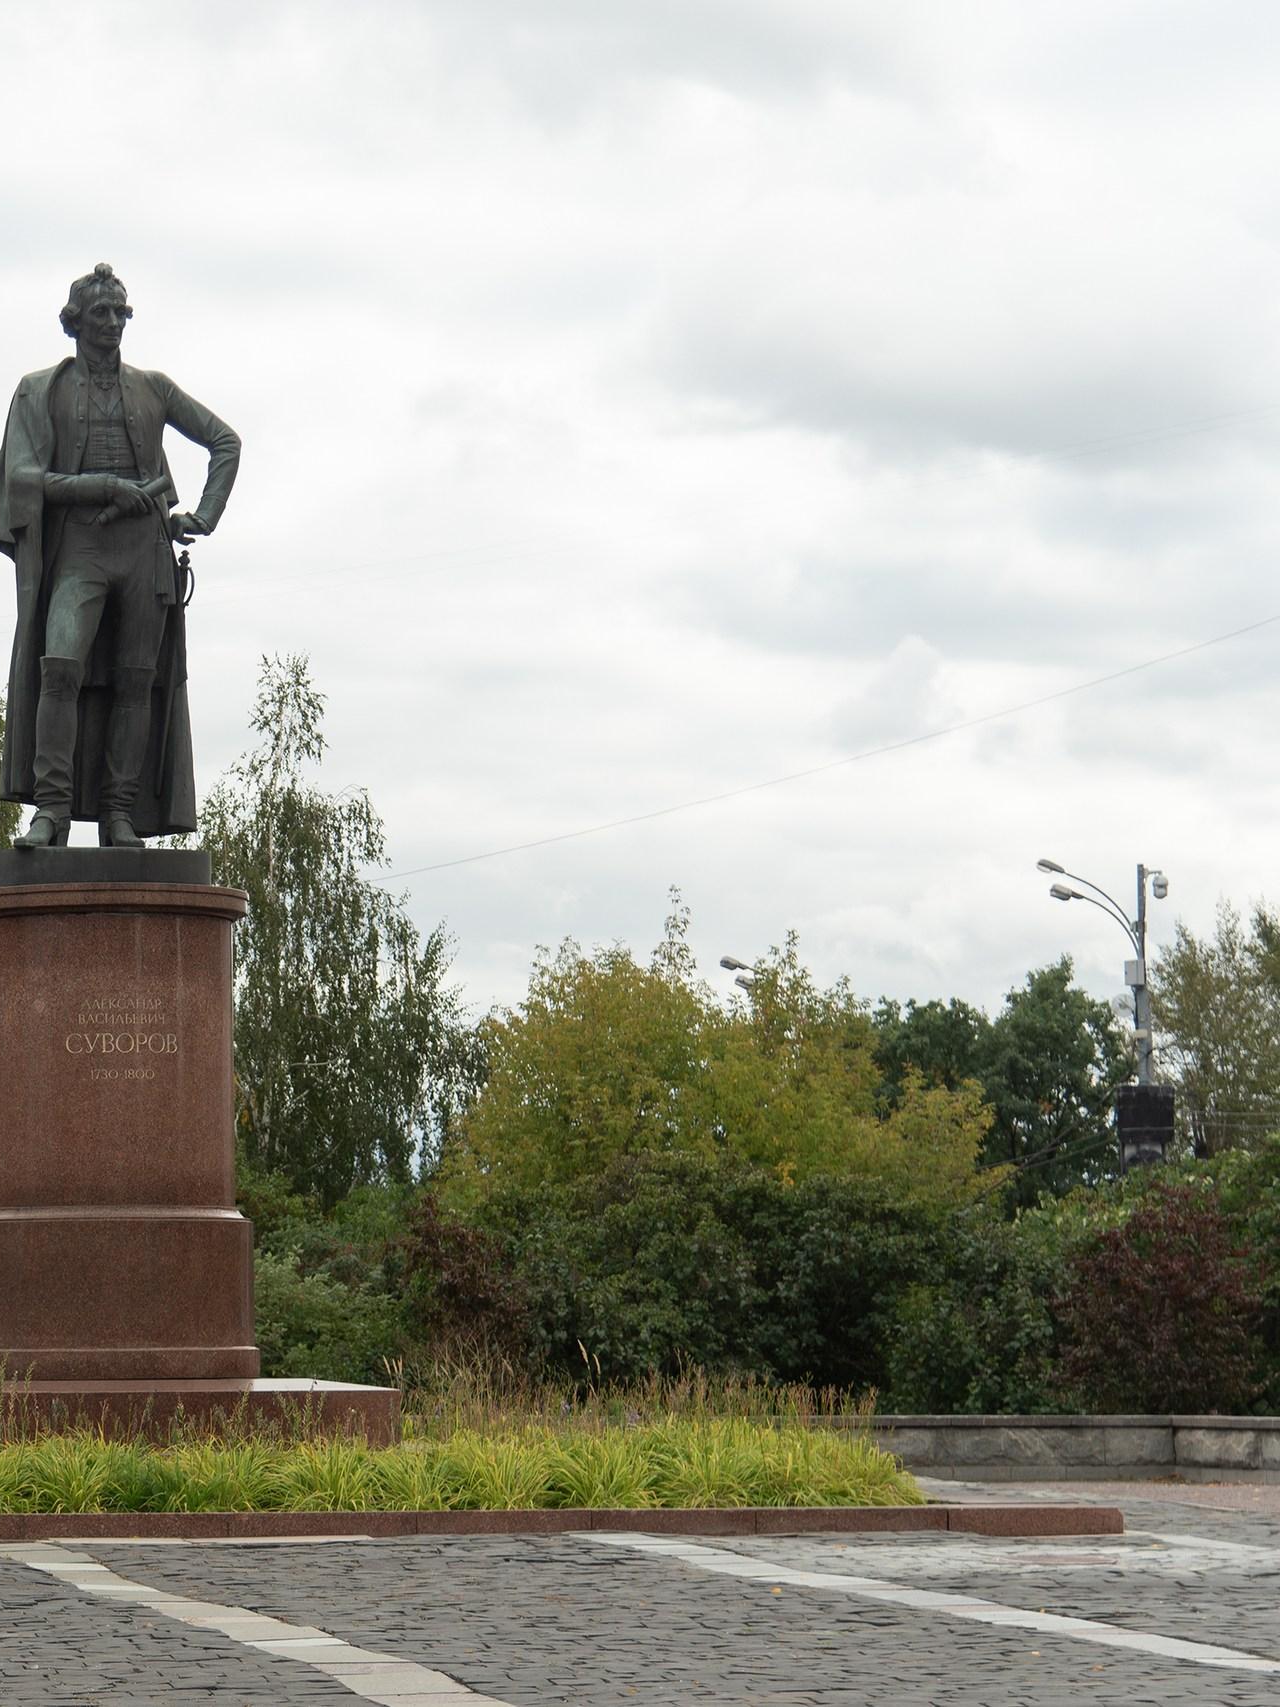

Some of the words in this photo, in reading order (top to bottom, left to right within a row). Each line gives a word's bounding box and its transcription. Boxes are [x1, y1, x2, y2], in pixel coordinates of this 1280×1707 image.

[81, 999, 162, 1010] АЛЕКСАНДР
[78, 1013, 165, 1025] ВАСИЛЬЕВИЧ
[65, 1032, 178, 1054] СУВОРОВ
